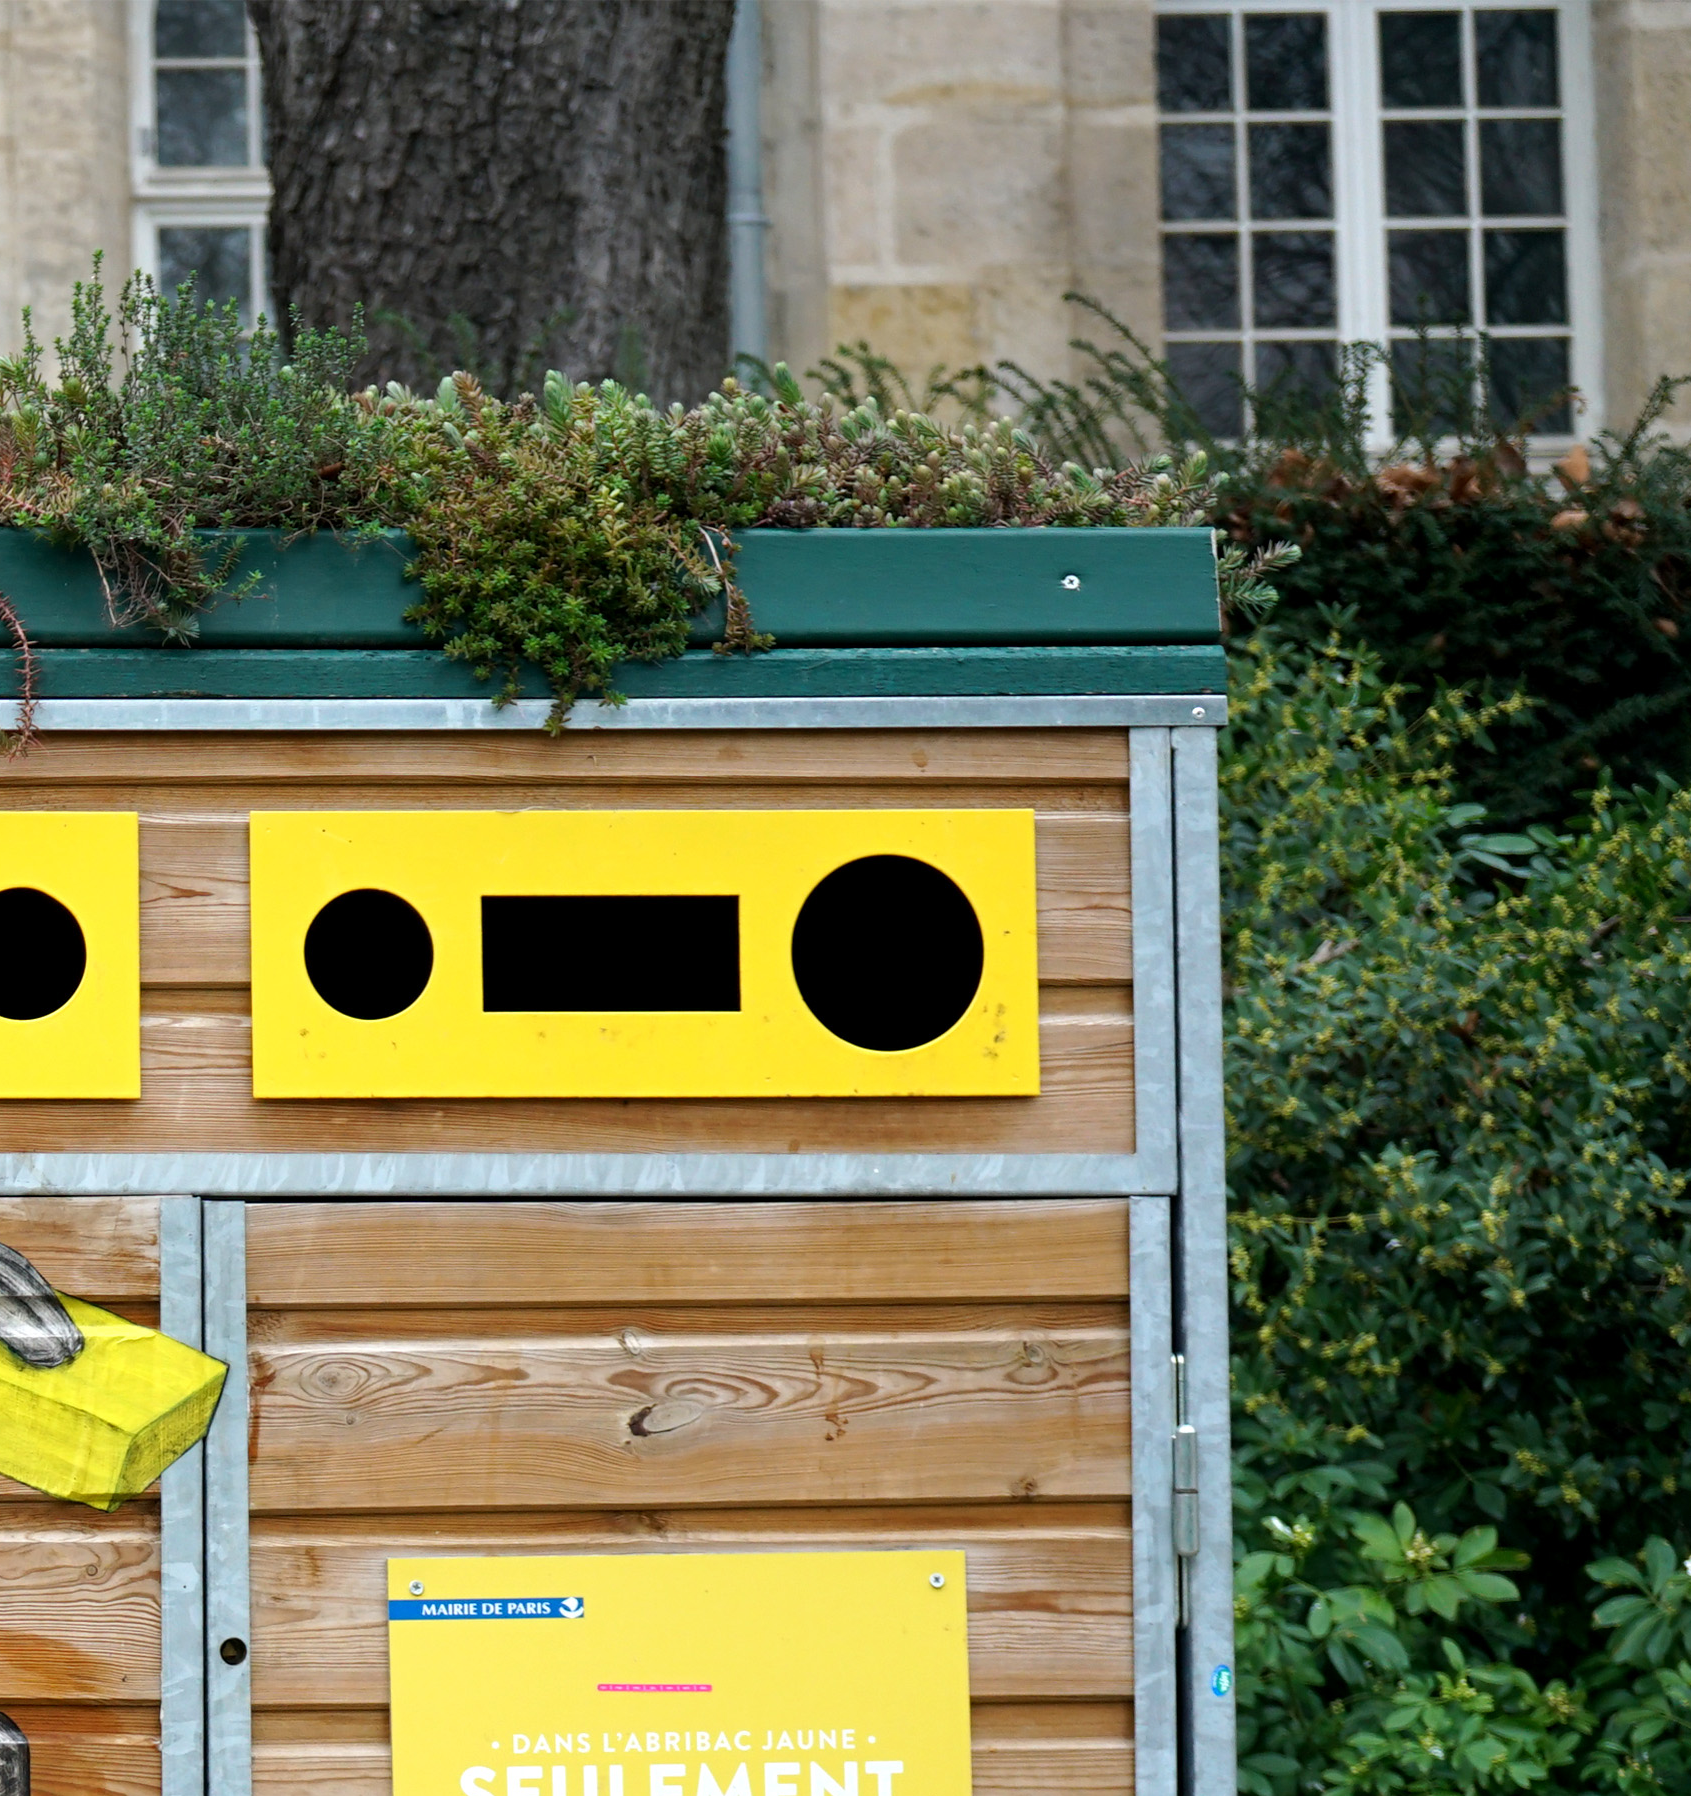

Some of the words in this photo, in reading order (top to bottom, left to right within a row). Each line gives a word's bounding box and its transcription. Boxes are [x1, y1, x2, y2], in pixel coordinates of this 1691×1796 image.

[421, 1602, 478, 1616] MAIRIE
[481, 1602, 503, 1616] DE
[507, 1601, 552, 1615] PARIS
[512, 1732, 591, 1755] DANS
[602, 1729, 752, 1753] L'ABRIBAC
[761, 1728, 856, 1751] JAUNE
